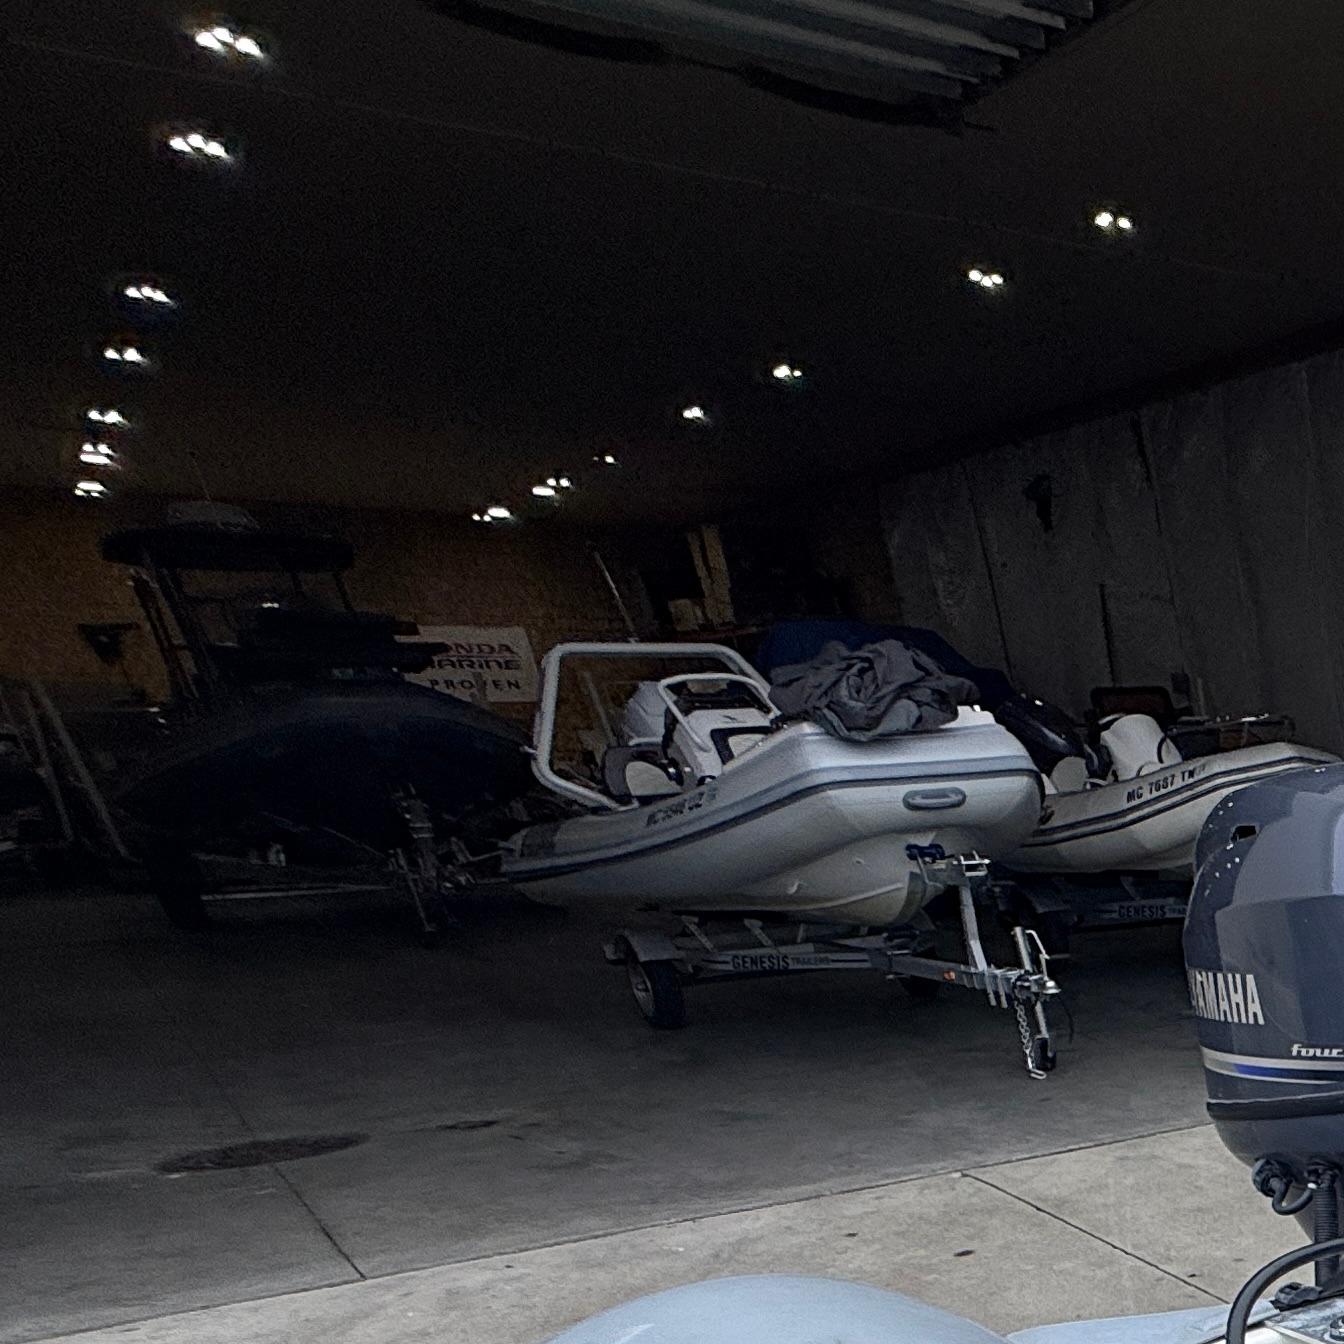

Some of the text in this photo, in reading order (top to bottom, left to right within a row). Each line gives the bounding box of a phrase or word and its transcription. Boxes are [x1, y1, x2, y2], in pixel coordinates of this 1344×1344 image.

[1126, 786, 1144, 804] MC
[1118, 904, 1167, 918] GENESIS
[732, 955, 790, 970] GENESIS
